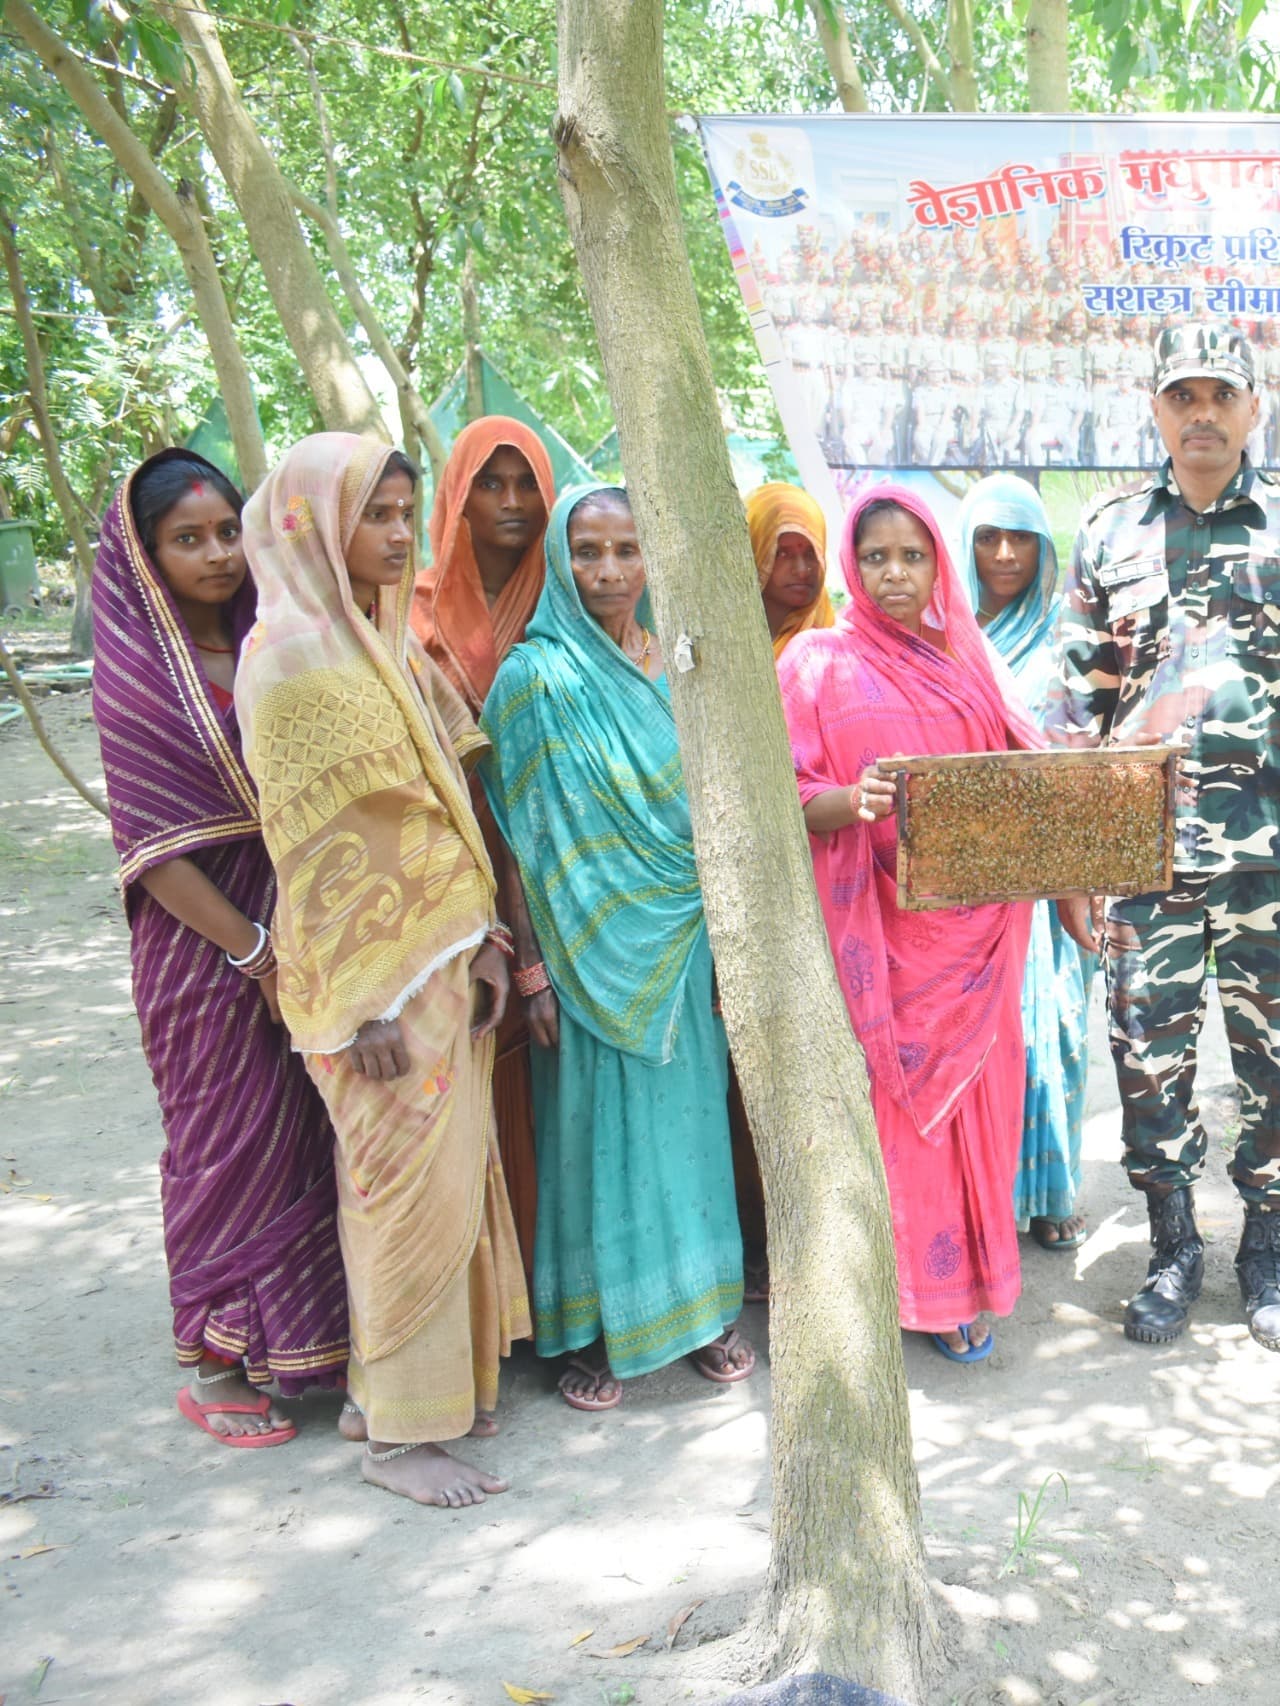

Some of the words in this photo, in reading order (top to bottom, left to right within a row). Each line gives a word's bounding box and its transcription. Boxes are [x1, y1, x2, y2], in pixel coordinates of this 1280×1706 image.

[906, 165, 1104, 228] वैज्ञानिक
[1120, 226, 1212, 268] रिक्रूट
[1083, 286, 1192, 312] सशस्त्र
